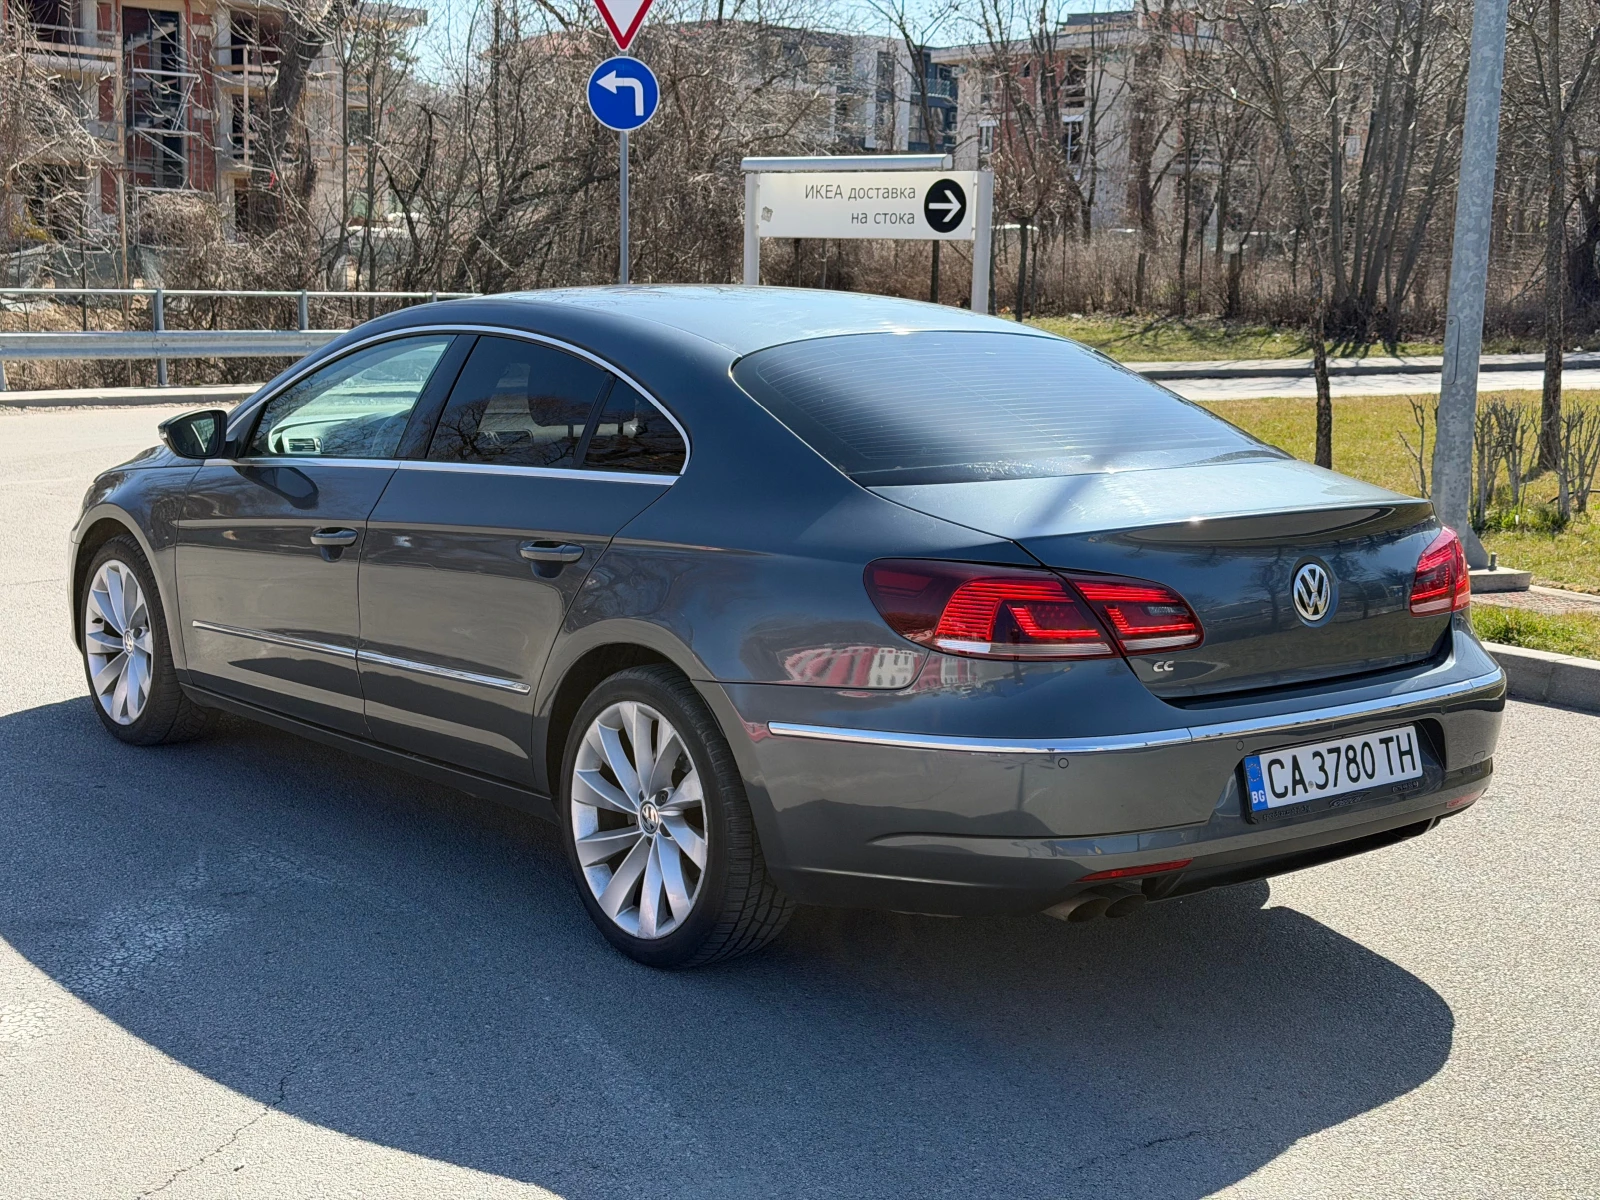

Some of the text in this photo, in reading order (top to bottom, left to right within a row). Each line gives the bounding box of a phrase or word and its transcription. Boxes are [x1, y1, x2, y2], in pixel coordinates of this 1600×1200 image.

[805, 184, 916, 201] ИКЕА доставка
[851, 212, 915, 225] на стока
[1152, 660, 1174, 672] CC
[1267, 733, 1417, 799] CA 3780 TH
[1251, 789, 1266, 803] BG
